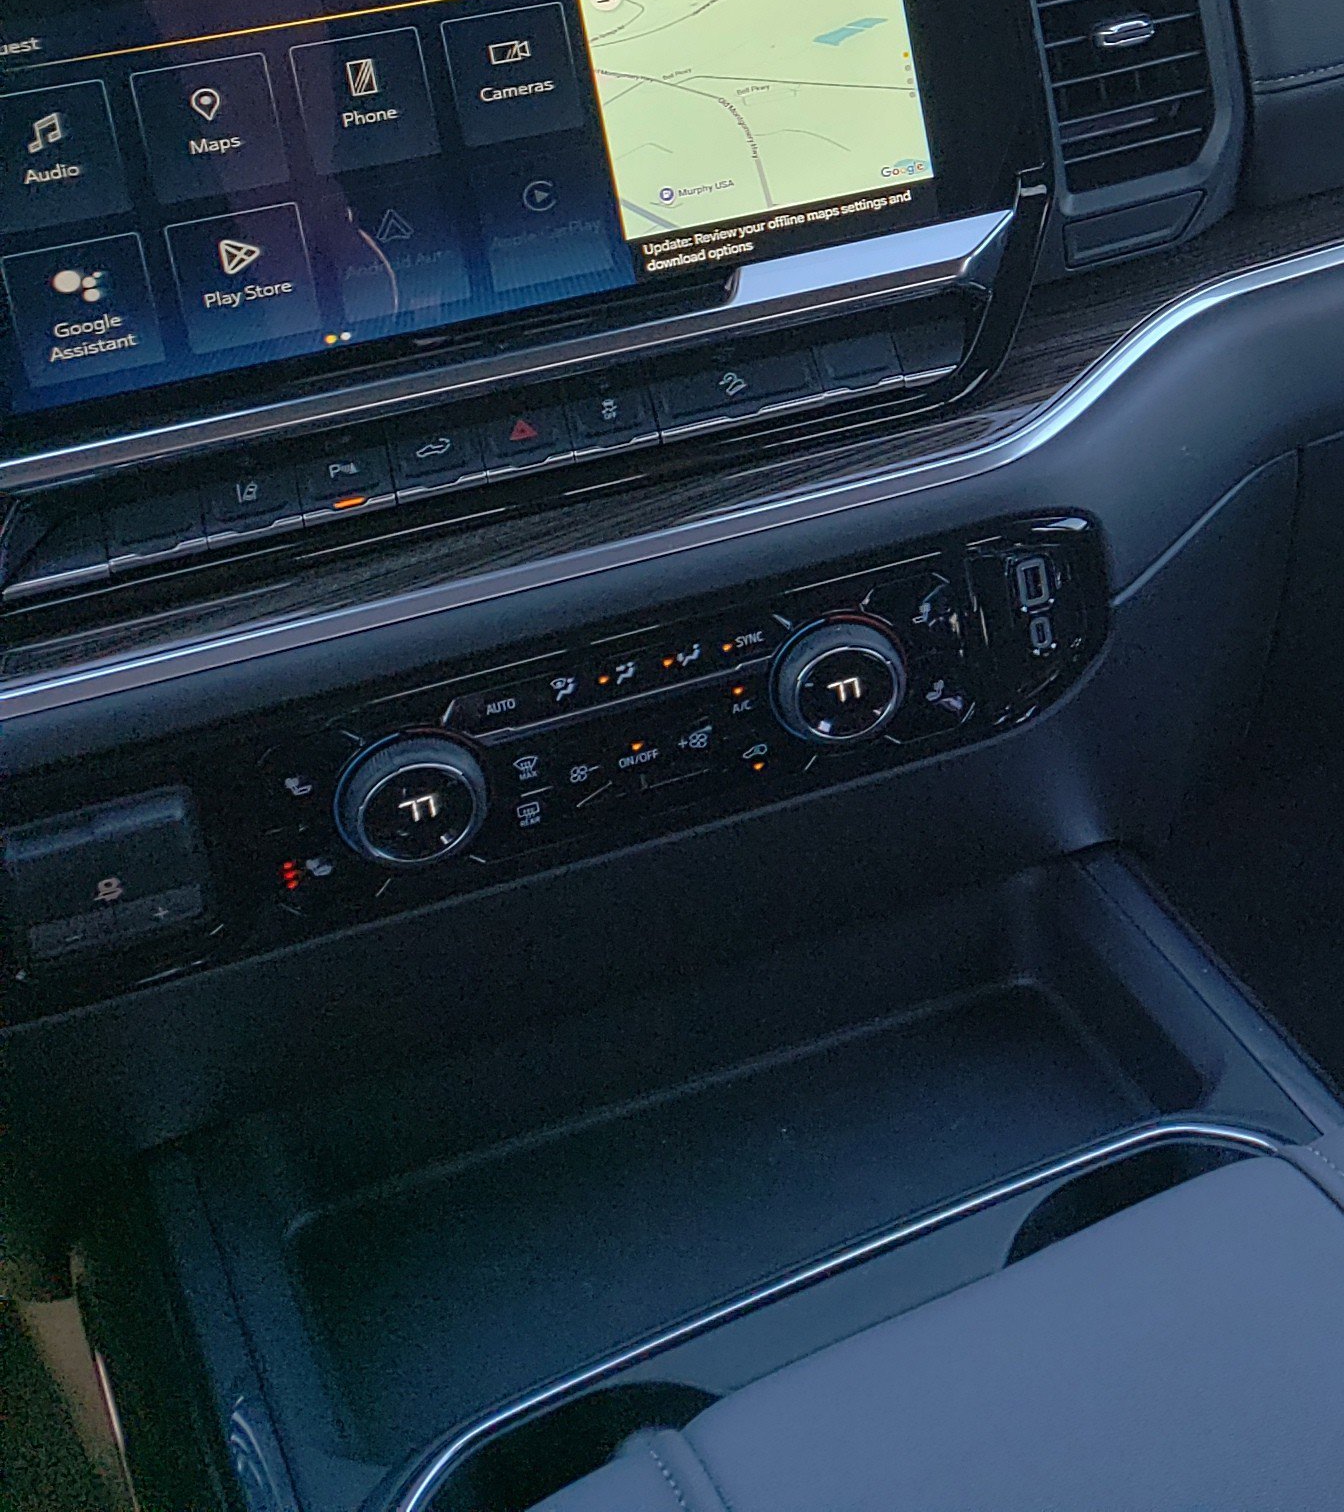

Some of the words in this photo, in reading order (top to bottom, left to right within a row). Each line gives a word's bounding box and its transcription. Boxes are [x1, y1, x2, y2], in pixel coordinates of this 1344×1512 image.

[480, 80, 555, 102] Cameras
[718, 97, 730, 108] Old
[342, 108, 399, 128] Phone
[189, 135, 242, 155] Maps
[24, 163, 81, 184] Audio
[881, 161, 925, 177] Google
[678, 183, 713, 197] Murphy
[715, 179, 735, 190] USA
[642, 238, 693, 257] Update:
[694, 227, 737, 245] Review
[738, 221, 766, 239] your
[767, 213, 805, 230] offline
[807, 206, 840, 222] maps
[841, 196, 887, 215] settings
[889, 189, 912, 205] and
[646, 249, 706, 272] download
[708, 242, 754, 262] options
[204, 289, 241, 309] Play
[244, 281, 293, 301] Store
[54, 313, 122, 338] Google
[50, 333, 138, 362] Assistant
[734, 631, 764, 649] SYNC
[486, 698, 516, 716] AUTO
[732, 699, 753, 714] A/C
[618, 748, 660, 769] ON/OFF
